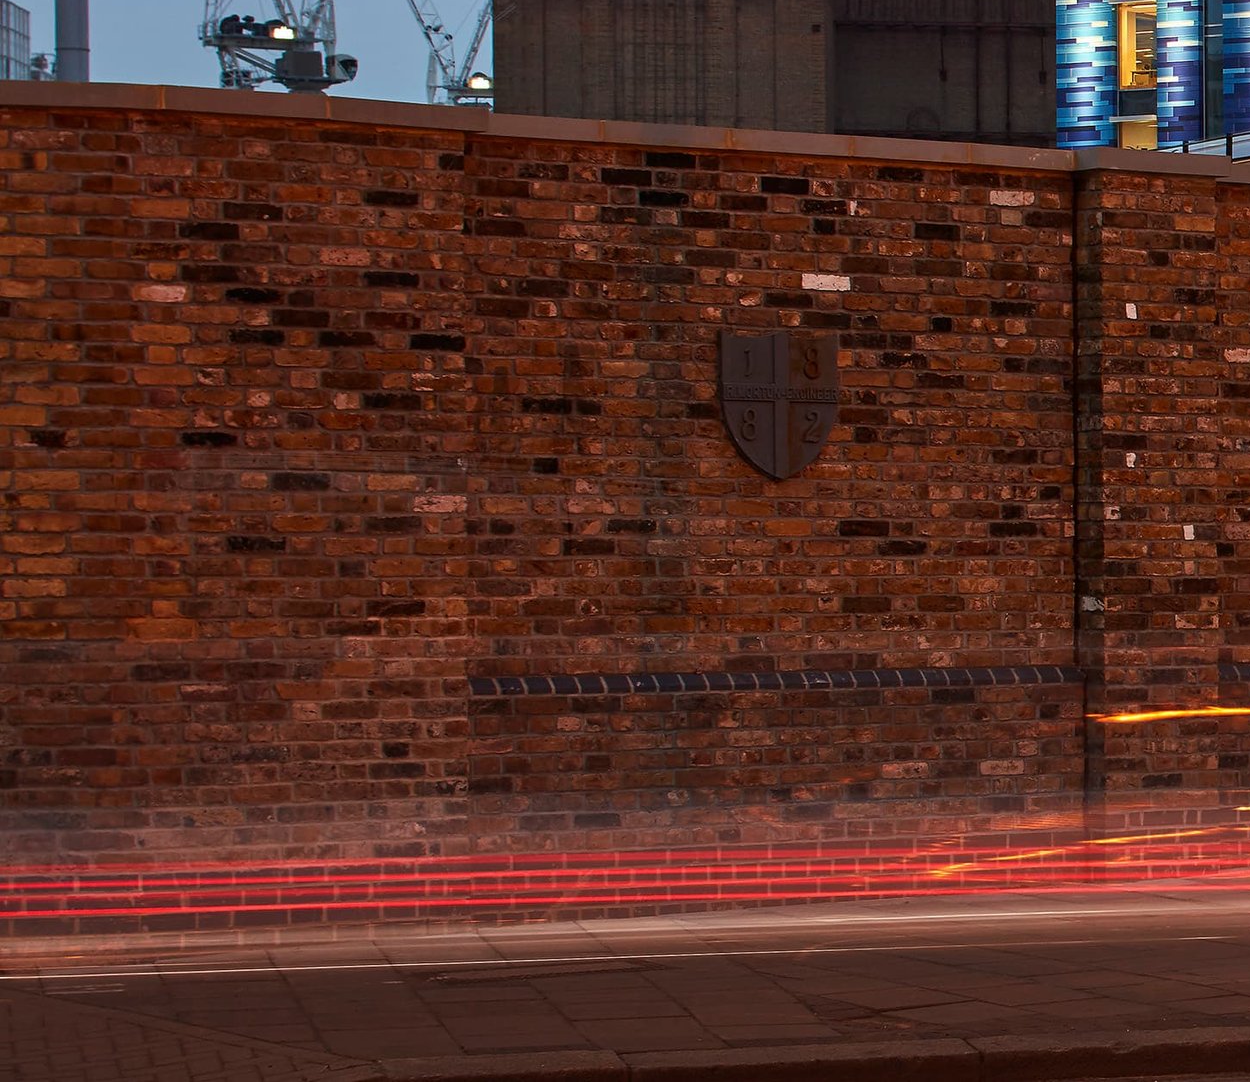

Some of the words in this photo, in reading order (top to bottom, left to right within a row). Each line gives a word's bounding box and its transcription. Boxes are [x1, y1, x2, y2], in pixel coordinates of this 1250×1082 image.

[803, 347, 820, 380] 8
[740, 409, 756, 442] 8
[803, 411, 821, 444] 2
